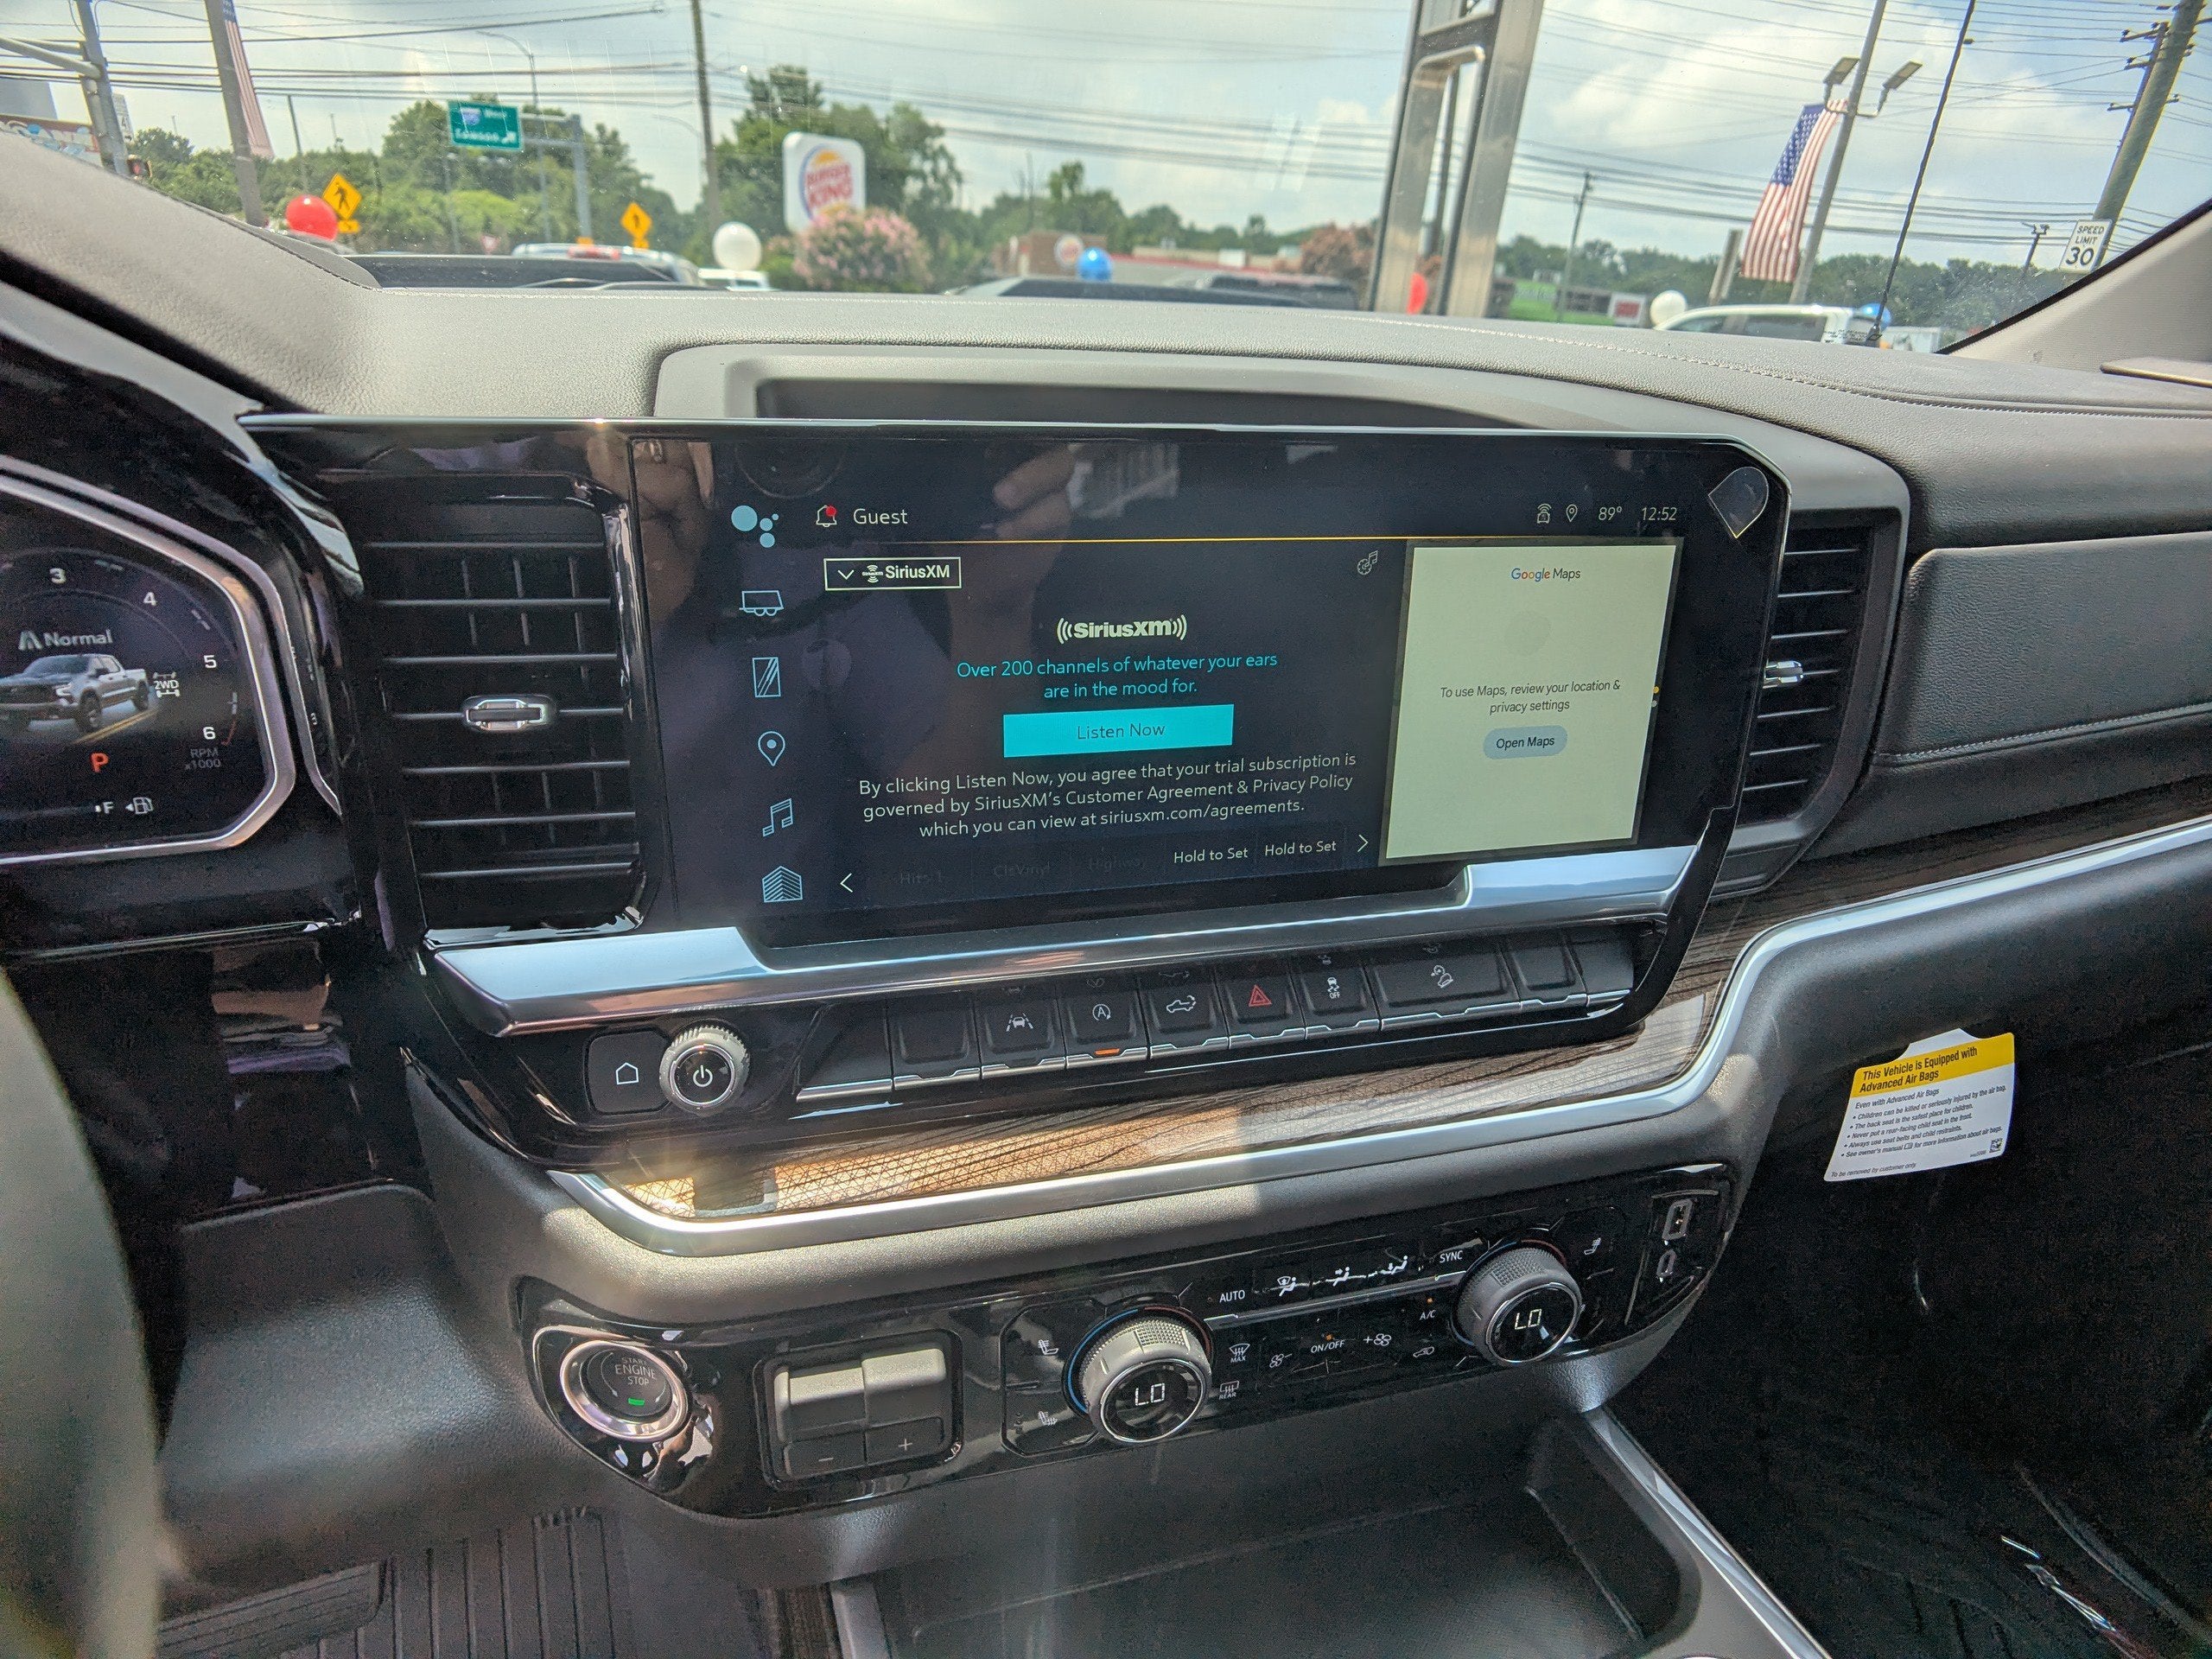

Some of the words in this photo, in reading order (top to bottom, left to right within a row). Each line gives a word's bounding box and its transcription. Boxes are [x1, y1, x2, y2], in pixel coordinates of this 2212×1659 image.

[2077, 226, 2105, 234] SPEED
[2066, 246, 2094, 265] 30
[854, 508, 908, 524] Guest
[1599, 506, 1622, 520] 89°
[1641, 507, 1677, 521] 12:52
[49, 568, 67, 584] 3
[885, 564, 950, 580] SiriusXM
[1511, 568, 1550, 582] Google
[1552, 568, 1581, 582] Maps
[143, 591, 157, 607] 4
[43, 629, 114, 648] Normal
[203, 654, 217, 669] 5
[957, 661, 996, 677] Over
[1001, 661, 1033, 677] 200
[1037, 657, 1109, 676] channels
[1114, 656, 1132, 672] of
[1135, 652, 1206, 671] whatever
[1208, 655, 1243, 673] your
[1246, 653, 1278, 668] ears
[154, 679, 180, 690] 2WD
[1044, 685, 1070, 699] are
[1074, 683, 1088, 698] in
[1092, 681, 1118, 696] the
[1122, 678, 1167, 696] mood
[1173, 677, 1198, 693] for.
[1440, 686, 1452, 698] To
[1455, 688, 1474, 697] use
[1477, 684, 1508, 699] Maps,
[1510, 683, 1545, 696] review
[1546, 683, 1569, 696] your
[1571, 680, 1611, 693] location
[1613, 679, 1621, 690] &
[1490, 701, 1528, 716] privacy
[1529, 699, 1570, 713] settings
[203, 726, 216, 741] 6
[1077, 725, 1123, 741] Listen
[1130, 722, 1165, 738] Now
[1496, 737, 1524, 751] Open
[1527, 735, 1555, 749] Maps
[189, 747, 219, 759] RPM
[91, 753, 109, 773] P
[859, 780, 880, 798] By
[886, 776, 950, 795] clicking
[957, 773, 1007, 790] Listen
[1013, 771, 1053, 787] Now,
[1057, 771, 1086, 787] you
[1091, 768, 1136, 785] agree
[1141, 763, 1173, 779] that
[1176, 762, 1211, 780] your
[1214, 758, 1244, 773] trial
[1249, 755, 1340, 772] subscription
[1344, 753, 1357, 766] is
[863, 798, 945, 822] governed
[950, 798, 969, 817] by
[975, 791, 1061, 811] SiriusXM's
[1065, 789, 1143, 805] Customer
[1147, 780, 1233, 803] Agreement
[1236, 780, 1249, 794] &
[1253, 775, 1306, 794] Privacy
[1309, 772, 1353, 790] Policy
[103, 801, 115, 814] F
[918, 820, 969, 837] which
[973, 821, 1002, 838] you
[1007, 818, 1036, 832] can
[1040, 815, 1077, 830] view
[1080, 811, 1097, 826] at
[1100, 798, 1305, 825] siriusxm.com/agreements.
[1173, 849, 1205, 864] Hold
[1210, 849, 1224, 861] to
[1227, 846, 1249, 860] Set
[1264, 842, 1295, 856] Hold
[1299, 842, 1313, 855] to
[1316, 839, 1337, 852] Set
[1863, 1071, 1881, 1081] This
[1884, 1064, 1913, 1077] Vehicle
[1915, 1060, 1922, 1071] is
[1924, 1051, 1960, 1069] Equipped
[1961, 1046, 1978, 1059] with
[1859, 1077, 1904, 1093] Advanced
[1905, 1074, 1918, 1085] Air
[1919, 1070, 1939, 1082] Bags
[1886, 1093, 1916, 1104] Advanced
[1439, 1250, 1463, 1264] SYNC
[1218, 1289, 1246, 1303] AUTO
[1420, 1310, 1435, 1320] A/C
[1515, 1308, 1542, 1330] LO
[1310, 1339, 1345, 1354] ON/OFF
[1230, 1353, 1246, 1363] MAX
[614, 1363, 657, 1380] ENGINE
[627, 1376, 650, 1386] STOP
[1135, 1382, 1166, 1406] LO
[1218, 1390, 1237, 1400] REAR
